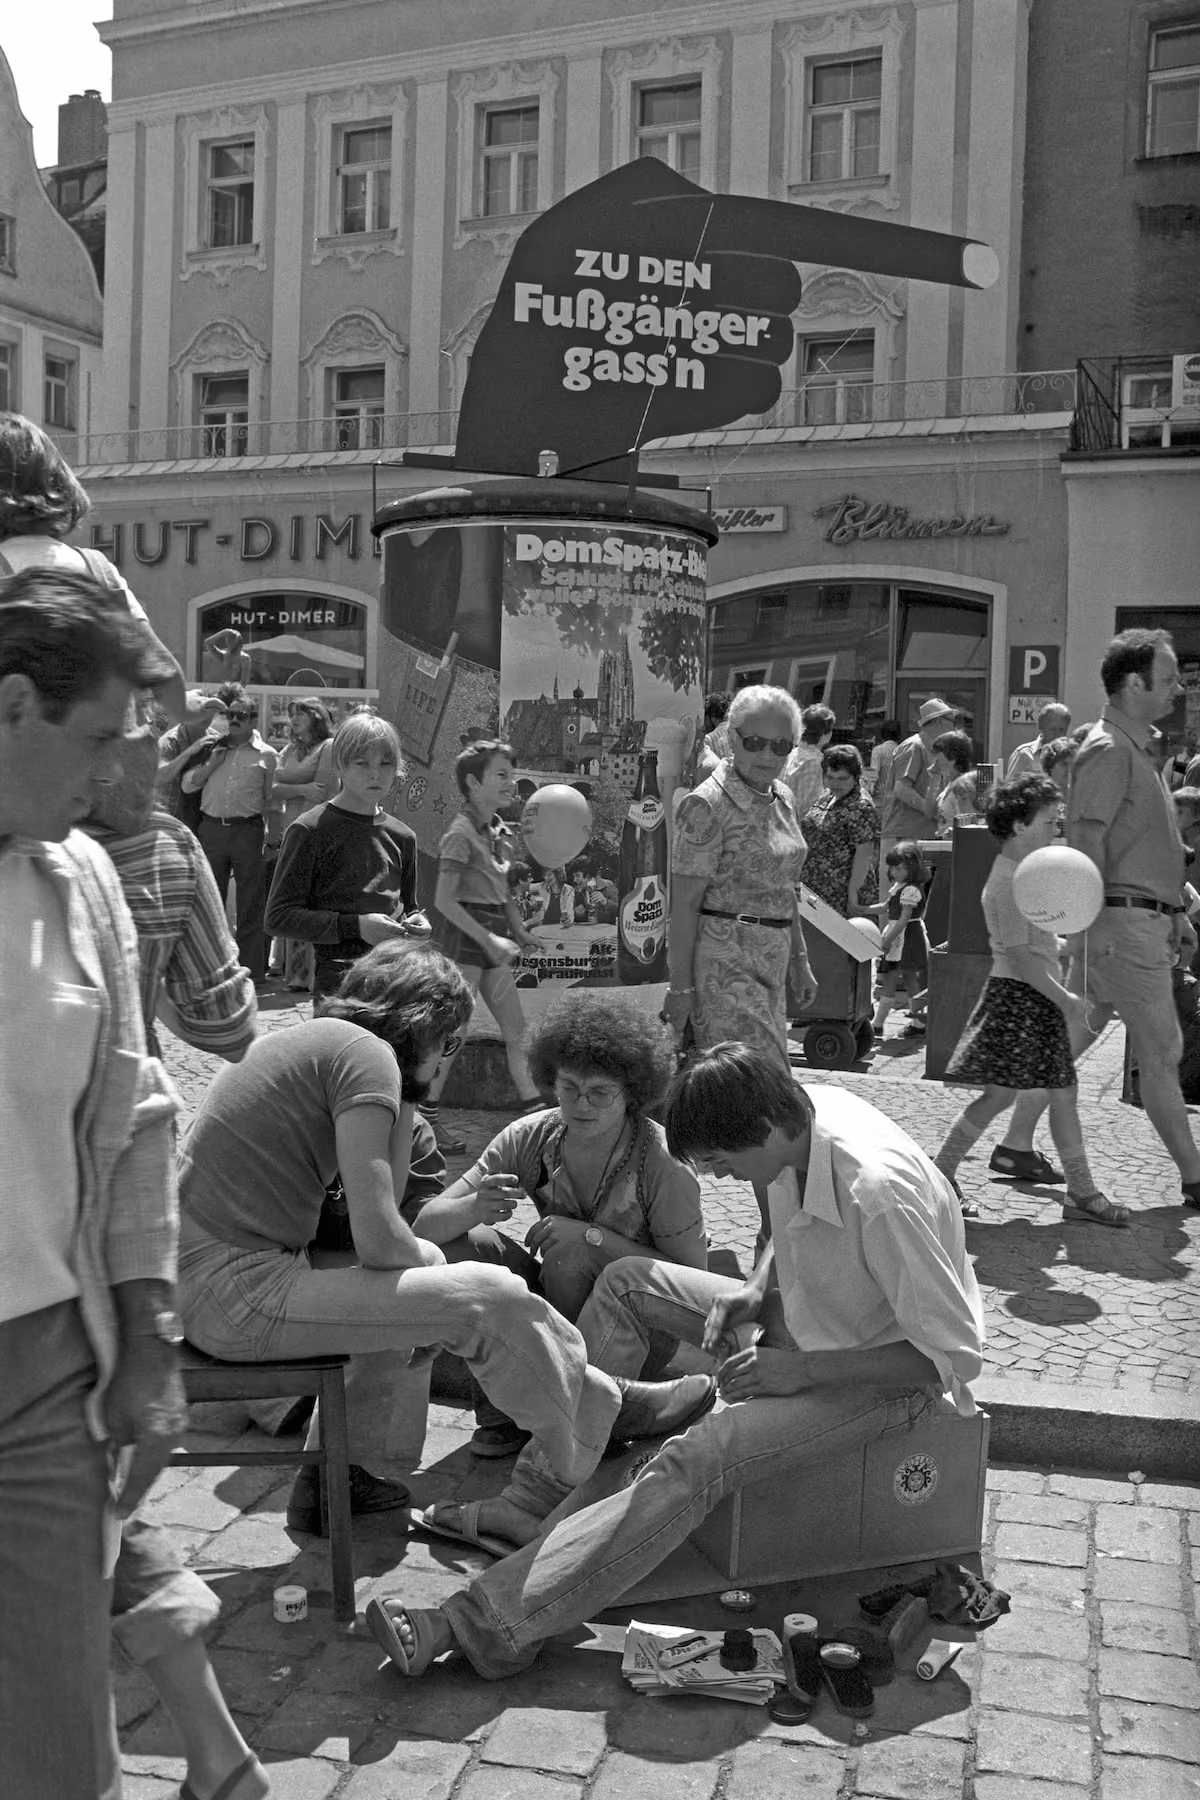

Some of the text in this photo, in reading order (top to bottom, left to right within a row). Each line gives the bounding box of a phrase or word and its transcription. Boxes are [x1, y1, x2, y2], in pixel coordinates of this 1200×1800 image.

[574, 249, 711, 290] ZU DEN
[514, 281, 771, 355] Fußgänger-
[812, 495, 1011, 545] Blumen
[540, 567, 630, 589] Schluck
[230, 610, 336, 625] HUT-DIMER
[1023, 649, 1047, 689] P
[637, 899, 662, 912] Dom
